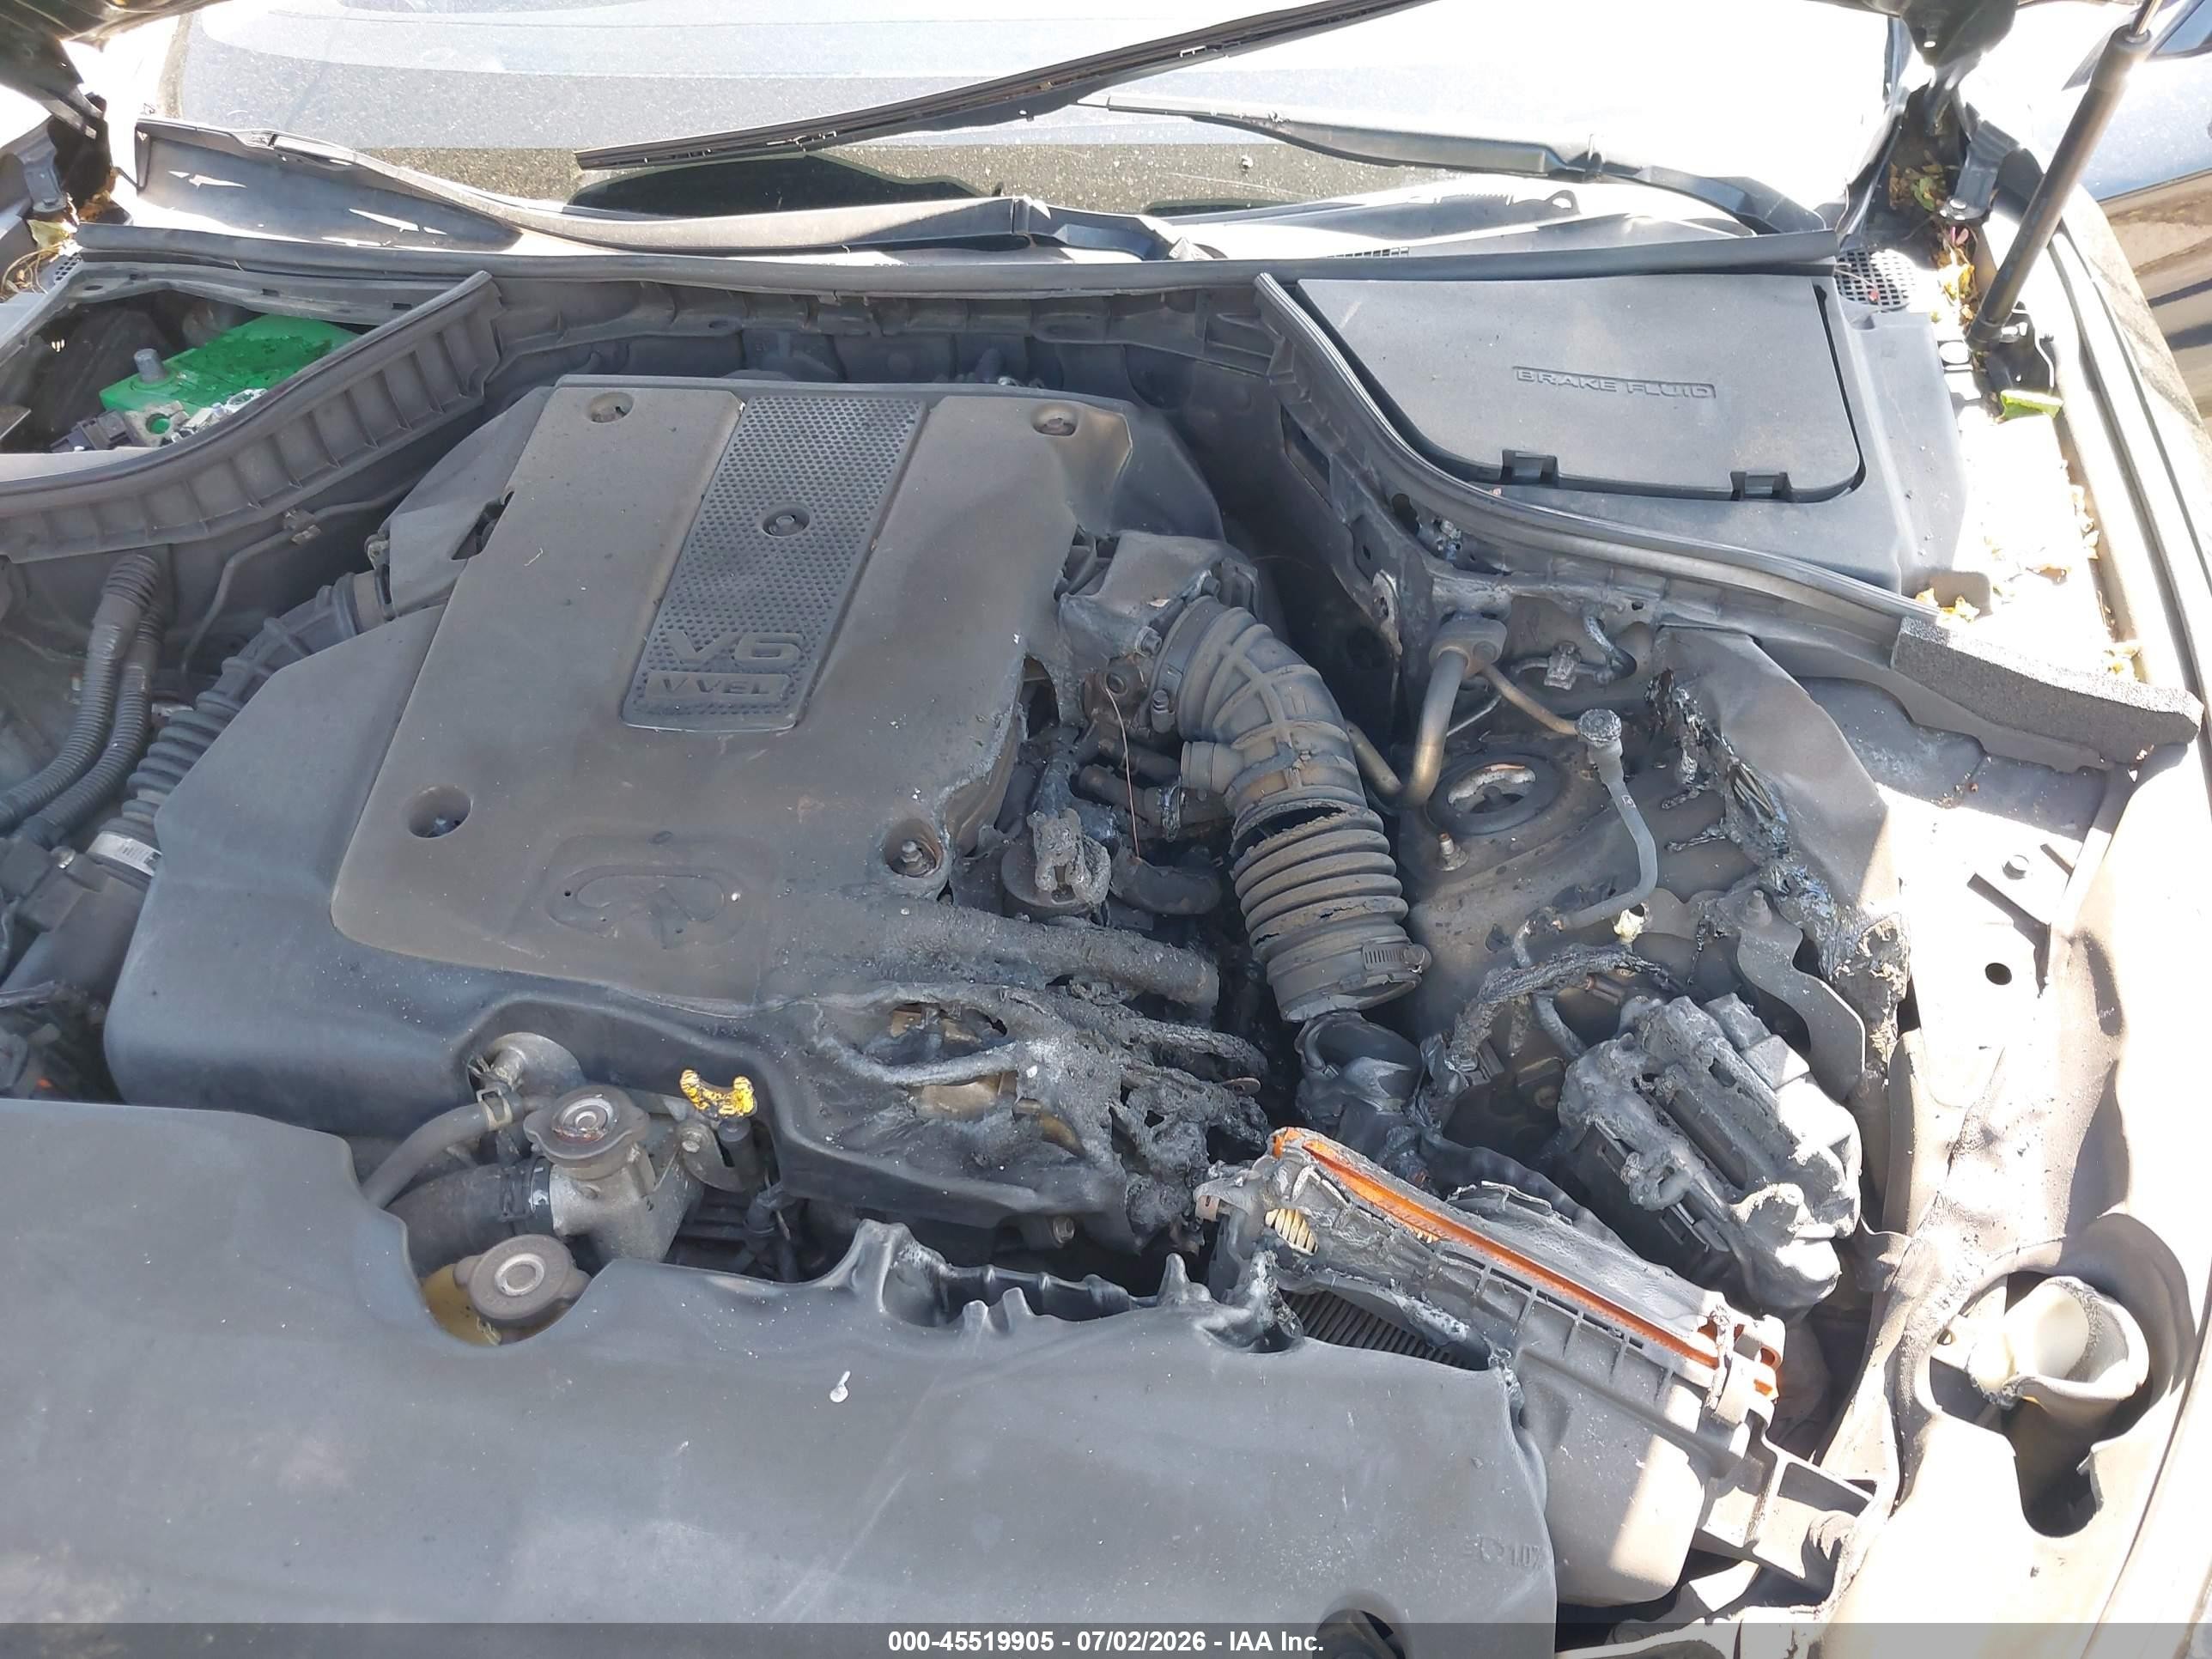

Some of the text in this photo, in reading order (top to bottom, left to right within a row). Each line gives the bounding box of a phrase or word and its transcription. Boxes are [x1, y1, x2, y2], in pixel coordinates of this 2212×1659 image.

[1516, 368, 1714, 399] BRAKE FLUID
[665, 630, 807, 666] V6
[662, 678, 770, 695] VVEL
